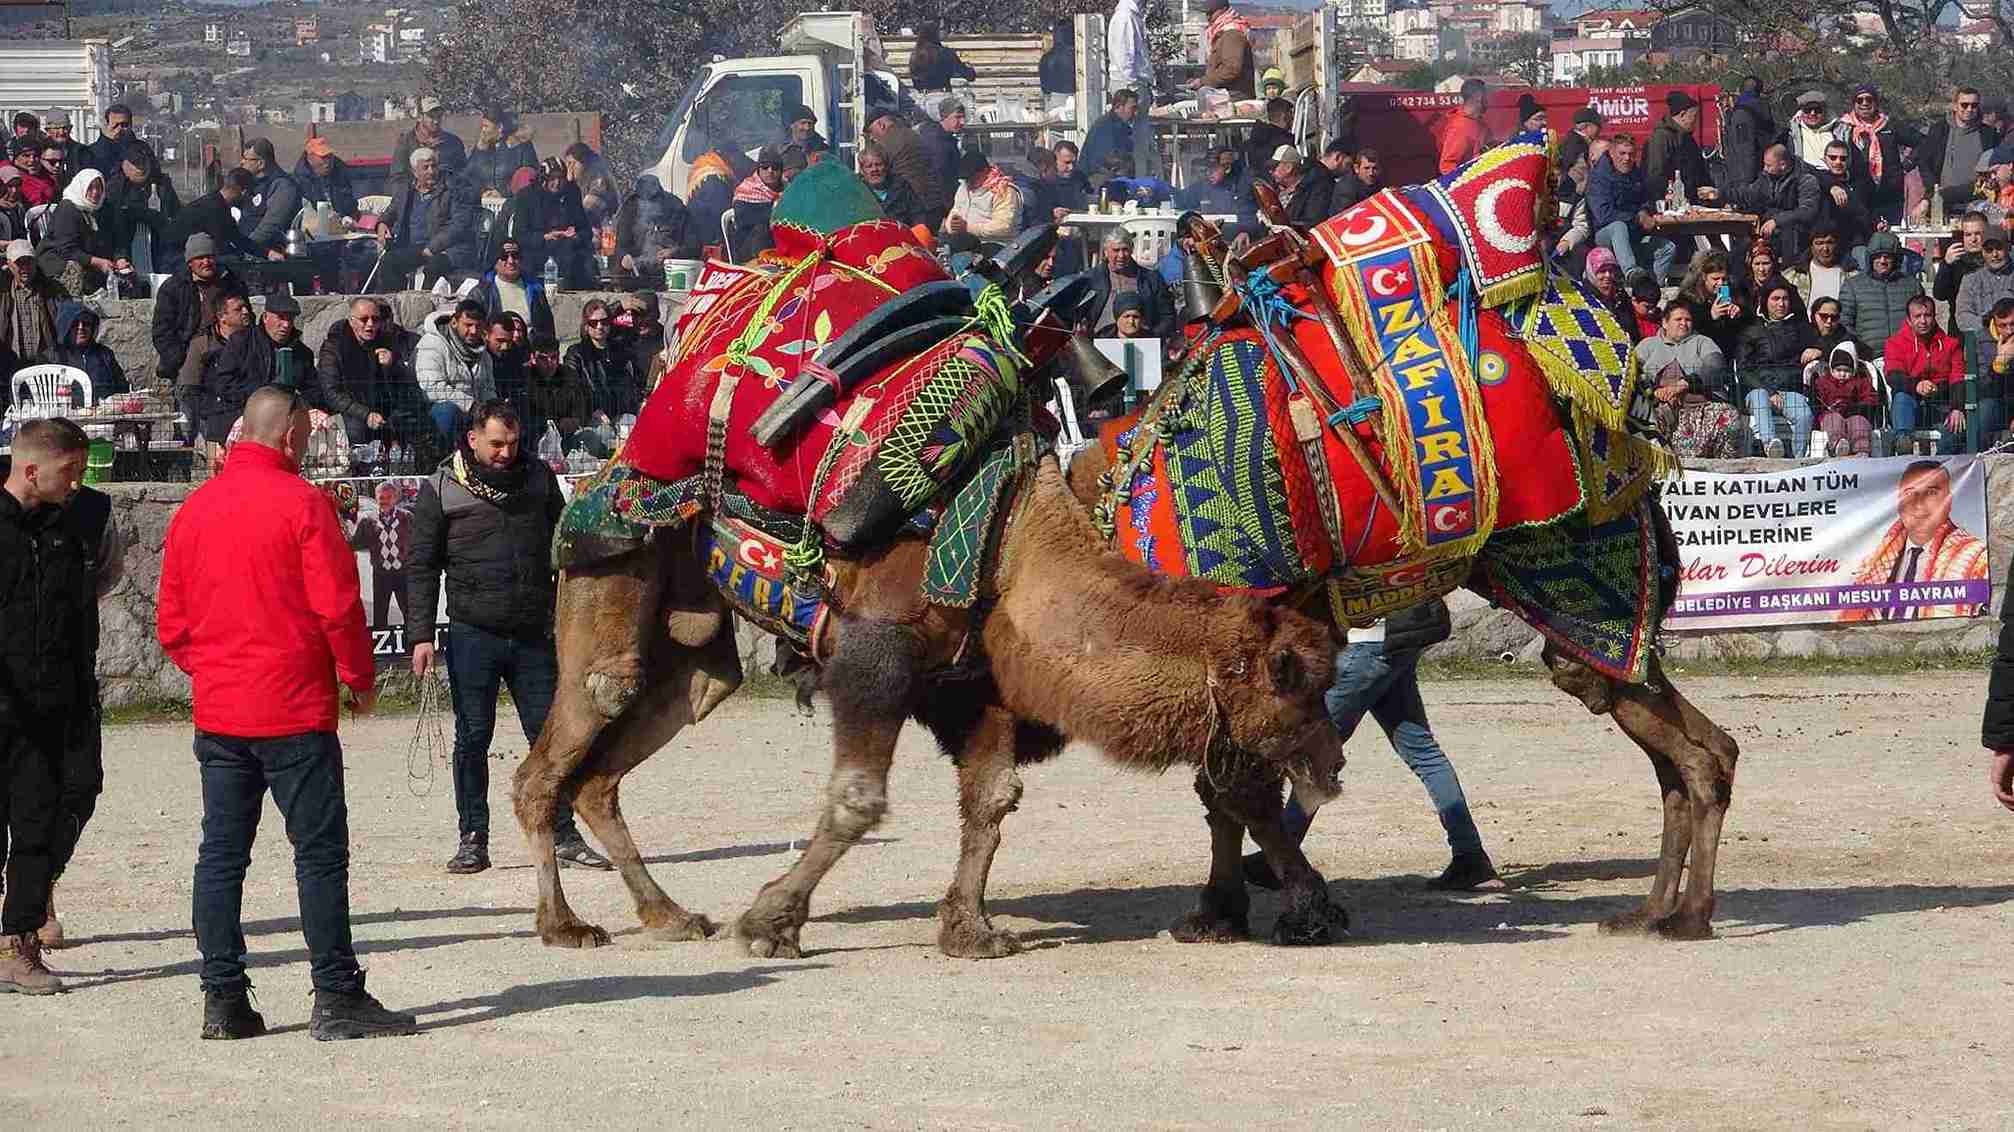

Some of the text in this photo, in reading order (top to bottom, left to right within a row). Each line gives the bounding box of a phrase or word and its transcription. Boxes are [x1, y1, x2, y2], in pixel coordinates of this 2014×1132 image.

[1586, 95, 1649, 116] ÖMÜR
[1378, 299, 1474, 500] ZAFİRA
[1713, 477, 1806, 495] KATILAN
[1813, 471, 1859, 491] TÜM
[1727, 500, 1837, 520] DEVELERE
[1673, 523, 1813, 546] SAHİPLERİNE
[1739, 552, 1841, 579] Dilerim
[1675, 586, 1967, 612] BELEDİYE BAŞKANI MESUT BAYRAM
